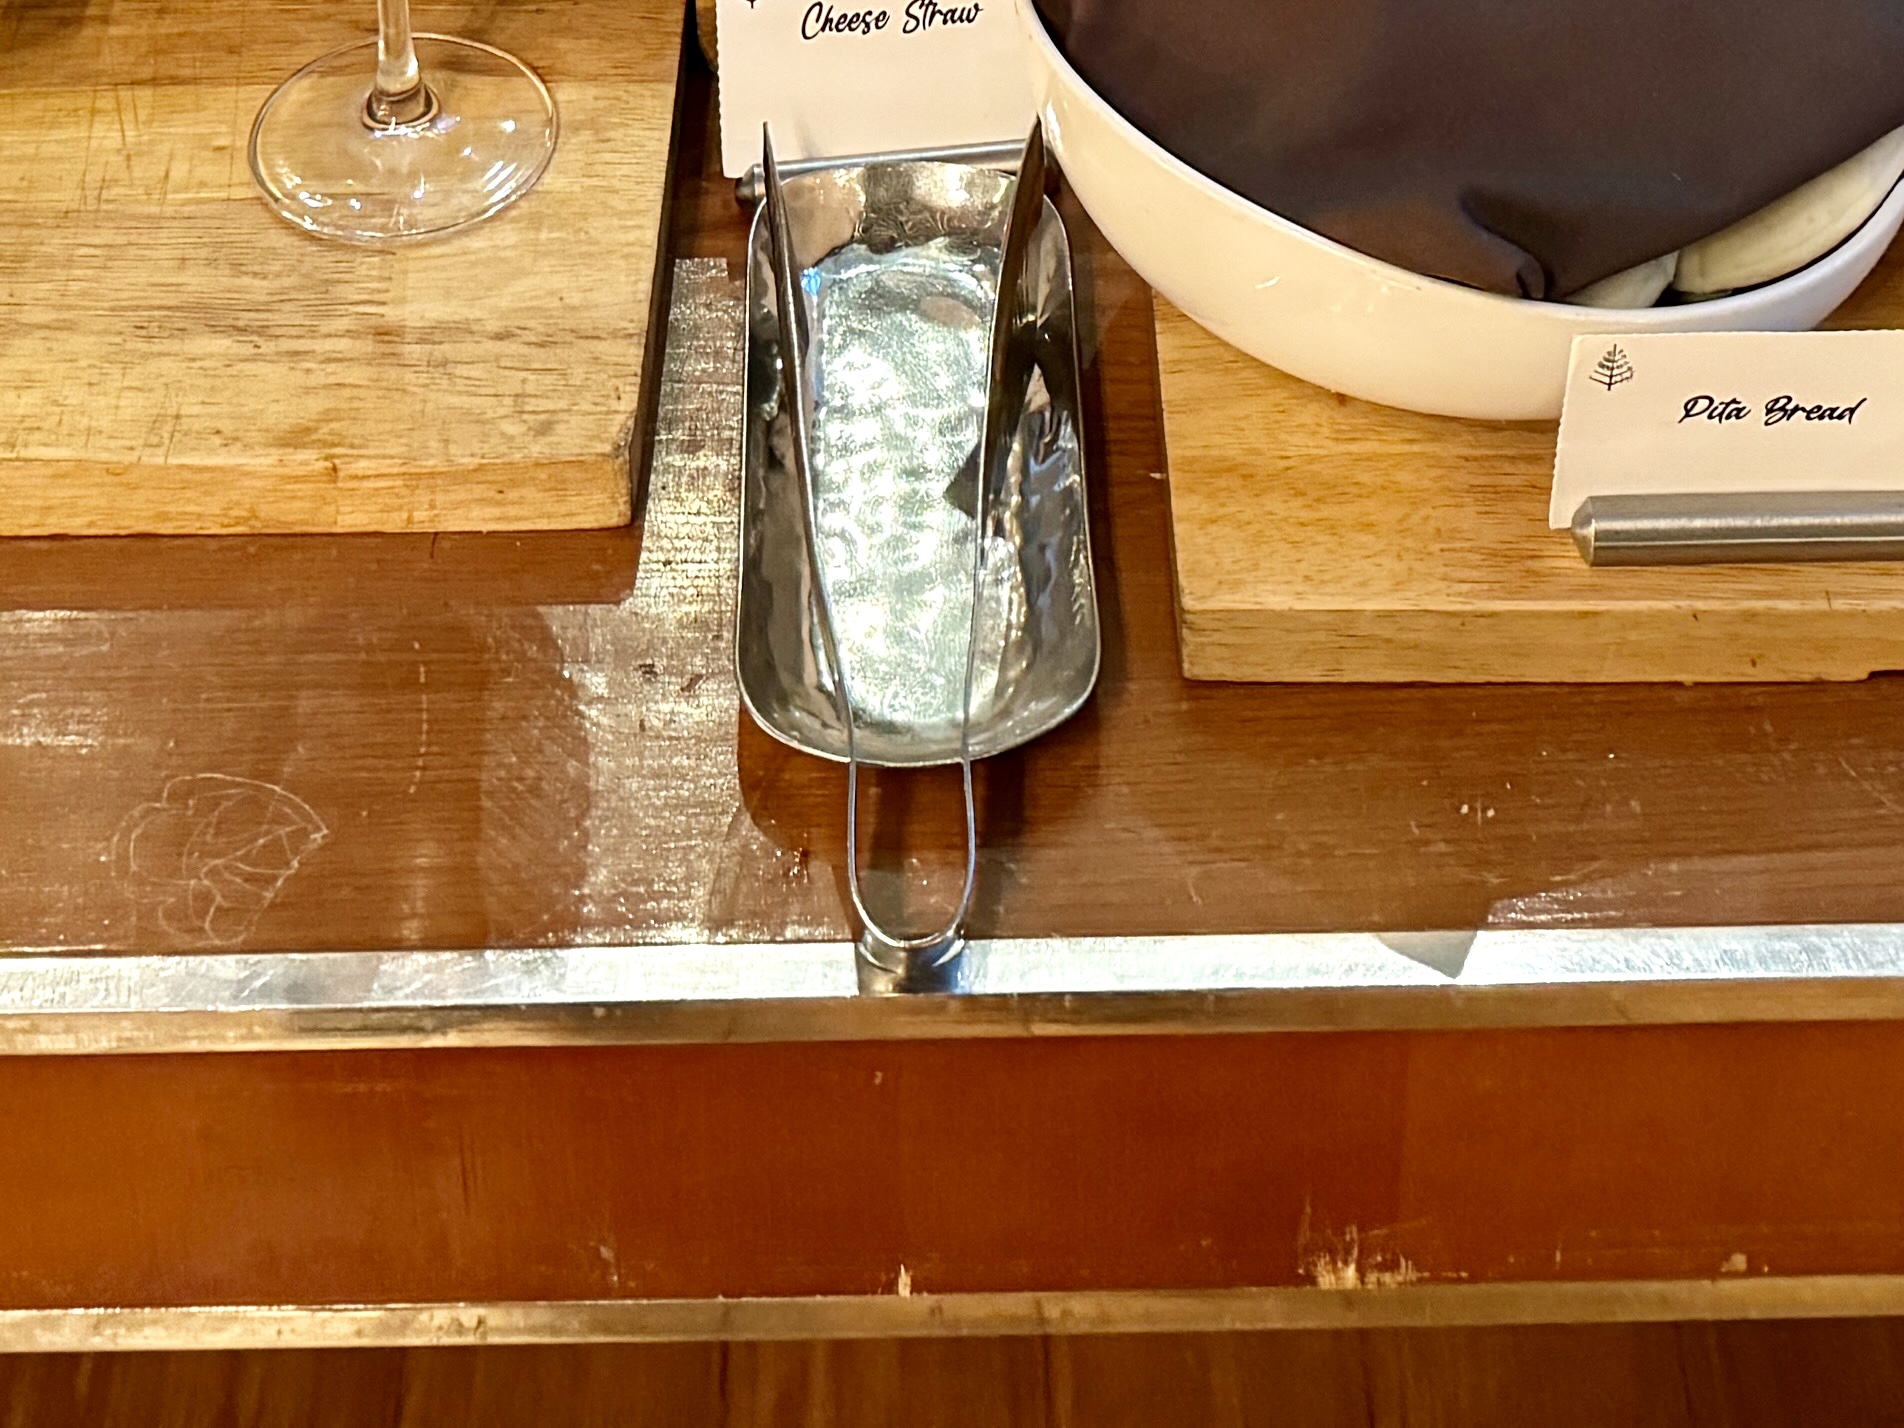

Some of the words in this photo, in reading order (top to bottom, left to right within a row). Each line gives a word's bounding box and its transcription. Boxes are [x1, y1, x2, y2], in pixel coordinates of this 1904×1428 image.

[800, 0, 891, 41] Cheese
[1677, 394, 1752, 425] Pita
[1763, 394, 1868, 427] Bread
